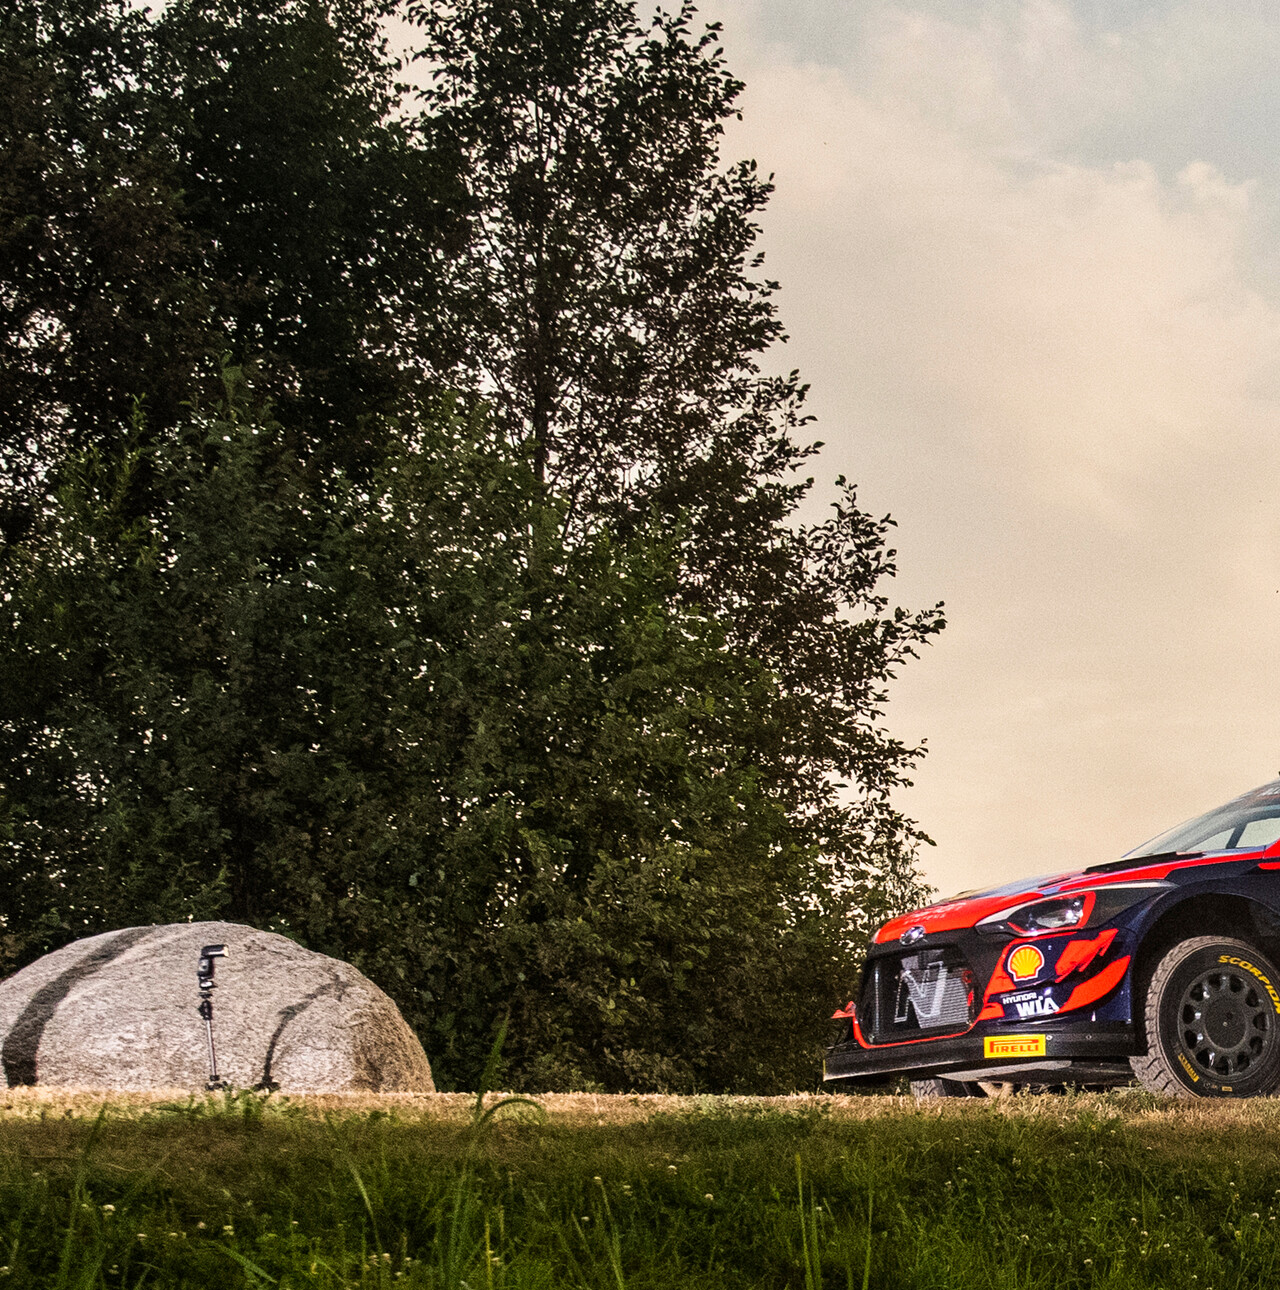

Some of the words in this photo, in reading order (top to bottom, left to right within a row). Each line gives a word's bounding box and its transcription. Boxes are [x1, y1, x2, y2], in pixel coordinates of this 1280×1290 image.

[1003, 992, 1037, 1005] HYUNDAI
[1016, 996, 1060, 1017] WIA
[989, 1038, 1039, 1053] PIRELLI
